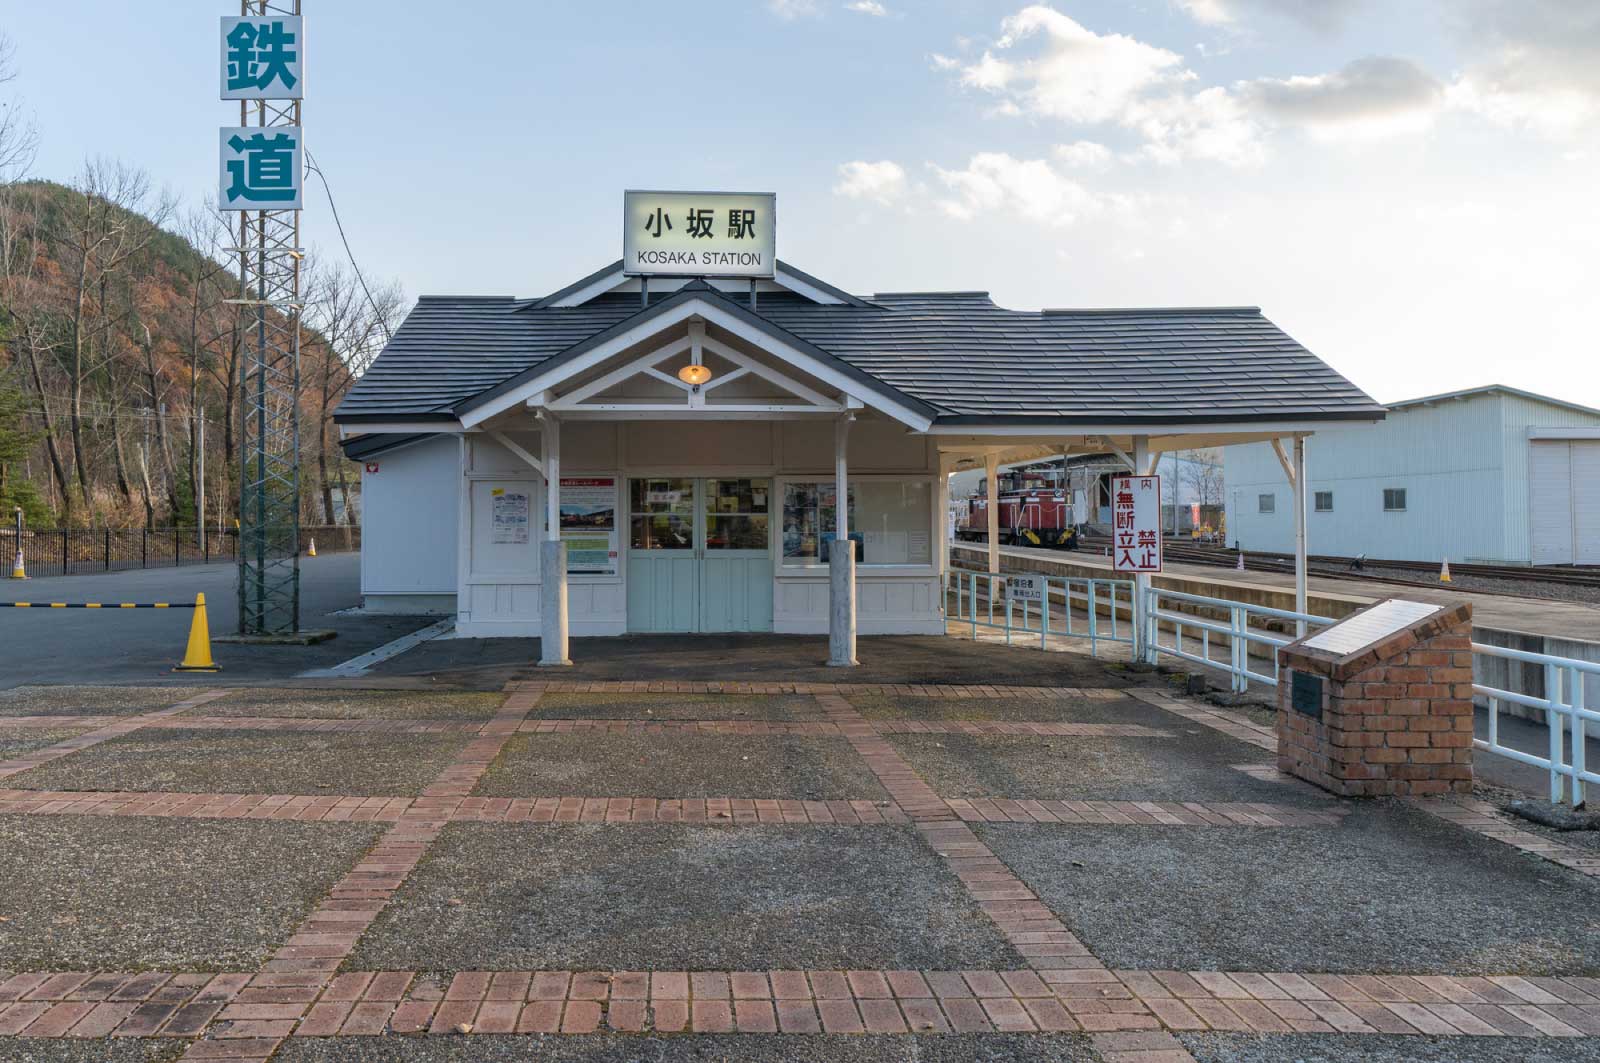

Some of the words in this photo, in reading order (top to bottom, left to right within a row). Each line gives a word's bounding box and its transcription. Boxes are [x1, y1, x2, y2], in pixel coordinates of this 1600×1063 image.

[226, 21, 297, 91] 鉄
[226, 132, 297, 203] 道
[644, 207, 756, 240] 小坂駅
[638, 251, 697, 265] KOSAKA
[702, 252, 761, 266] STATION
[1116, 491, 1136, 567] 無断立入
[1137, 530, 1157, 569] 禁止
